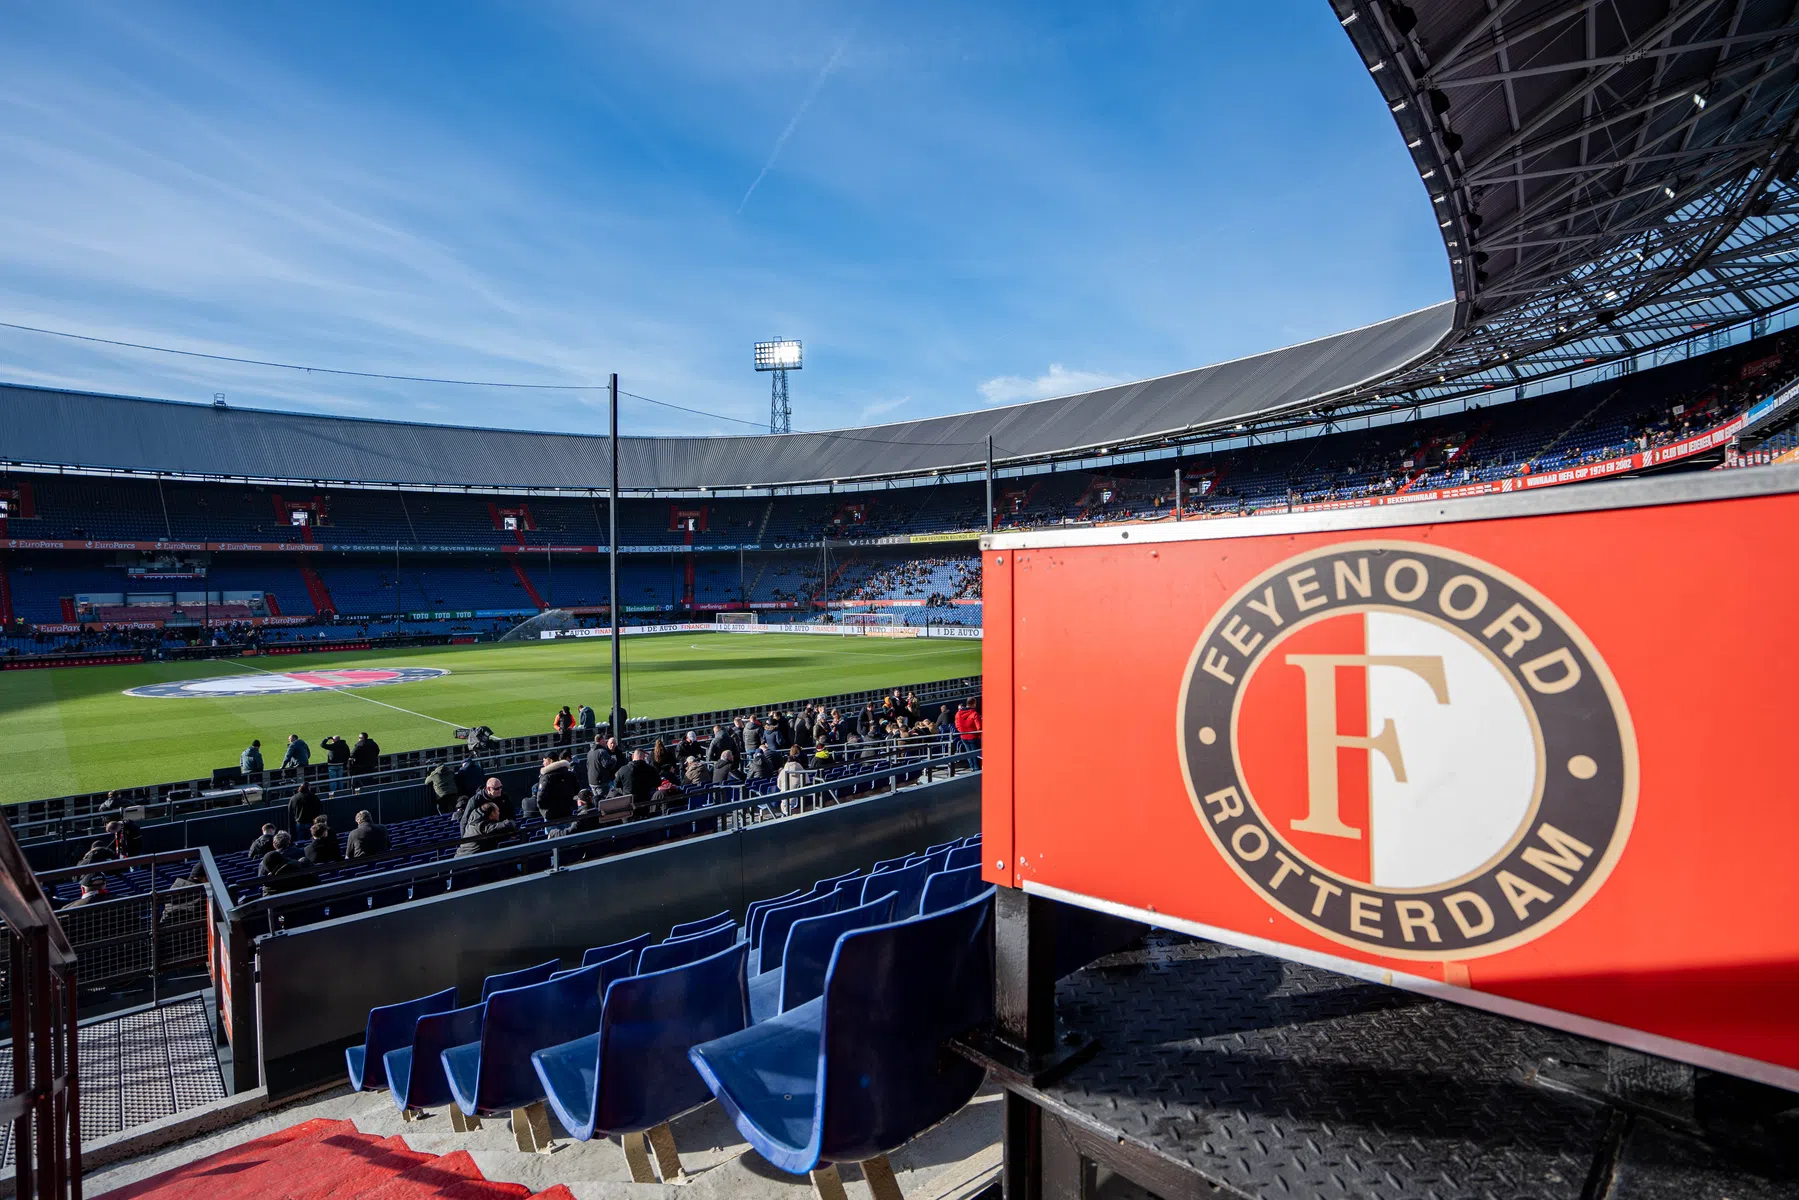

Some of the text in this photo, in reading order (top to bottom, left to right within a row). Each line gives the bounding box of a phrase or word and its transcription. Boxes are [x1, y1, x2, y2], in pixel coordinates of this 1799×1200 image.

[1662, 447, 1676, 460] CLUB
[1677, 443, 1688, 456] VAN
[1527, 458, 1631, 486] WINNAAR UEFA CUP 1974 EN 2002
[1387, 492, 1437, 504] BEKERWINNAAR
[19, 541, 64, 549] EuroParcs
[163, 542, 201, 550] EuroParcs
[227, 543, 262, 551] EuroParcs
[626, 604, 655, 612] Heineken
[41, 624, 81, 632] EuroParc
[1202, 558, 1581, 694] FEYENOORD
[944, 628, 980, 636] DE AUTO
[1285, 654, 1450, 839] F
[1204, 785, 1593, 942] ROTTERDAM
